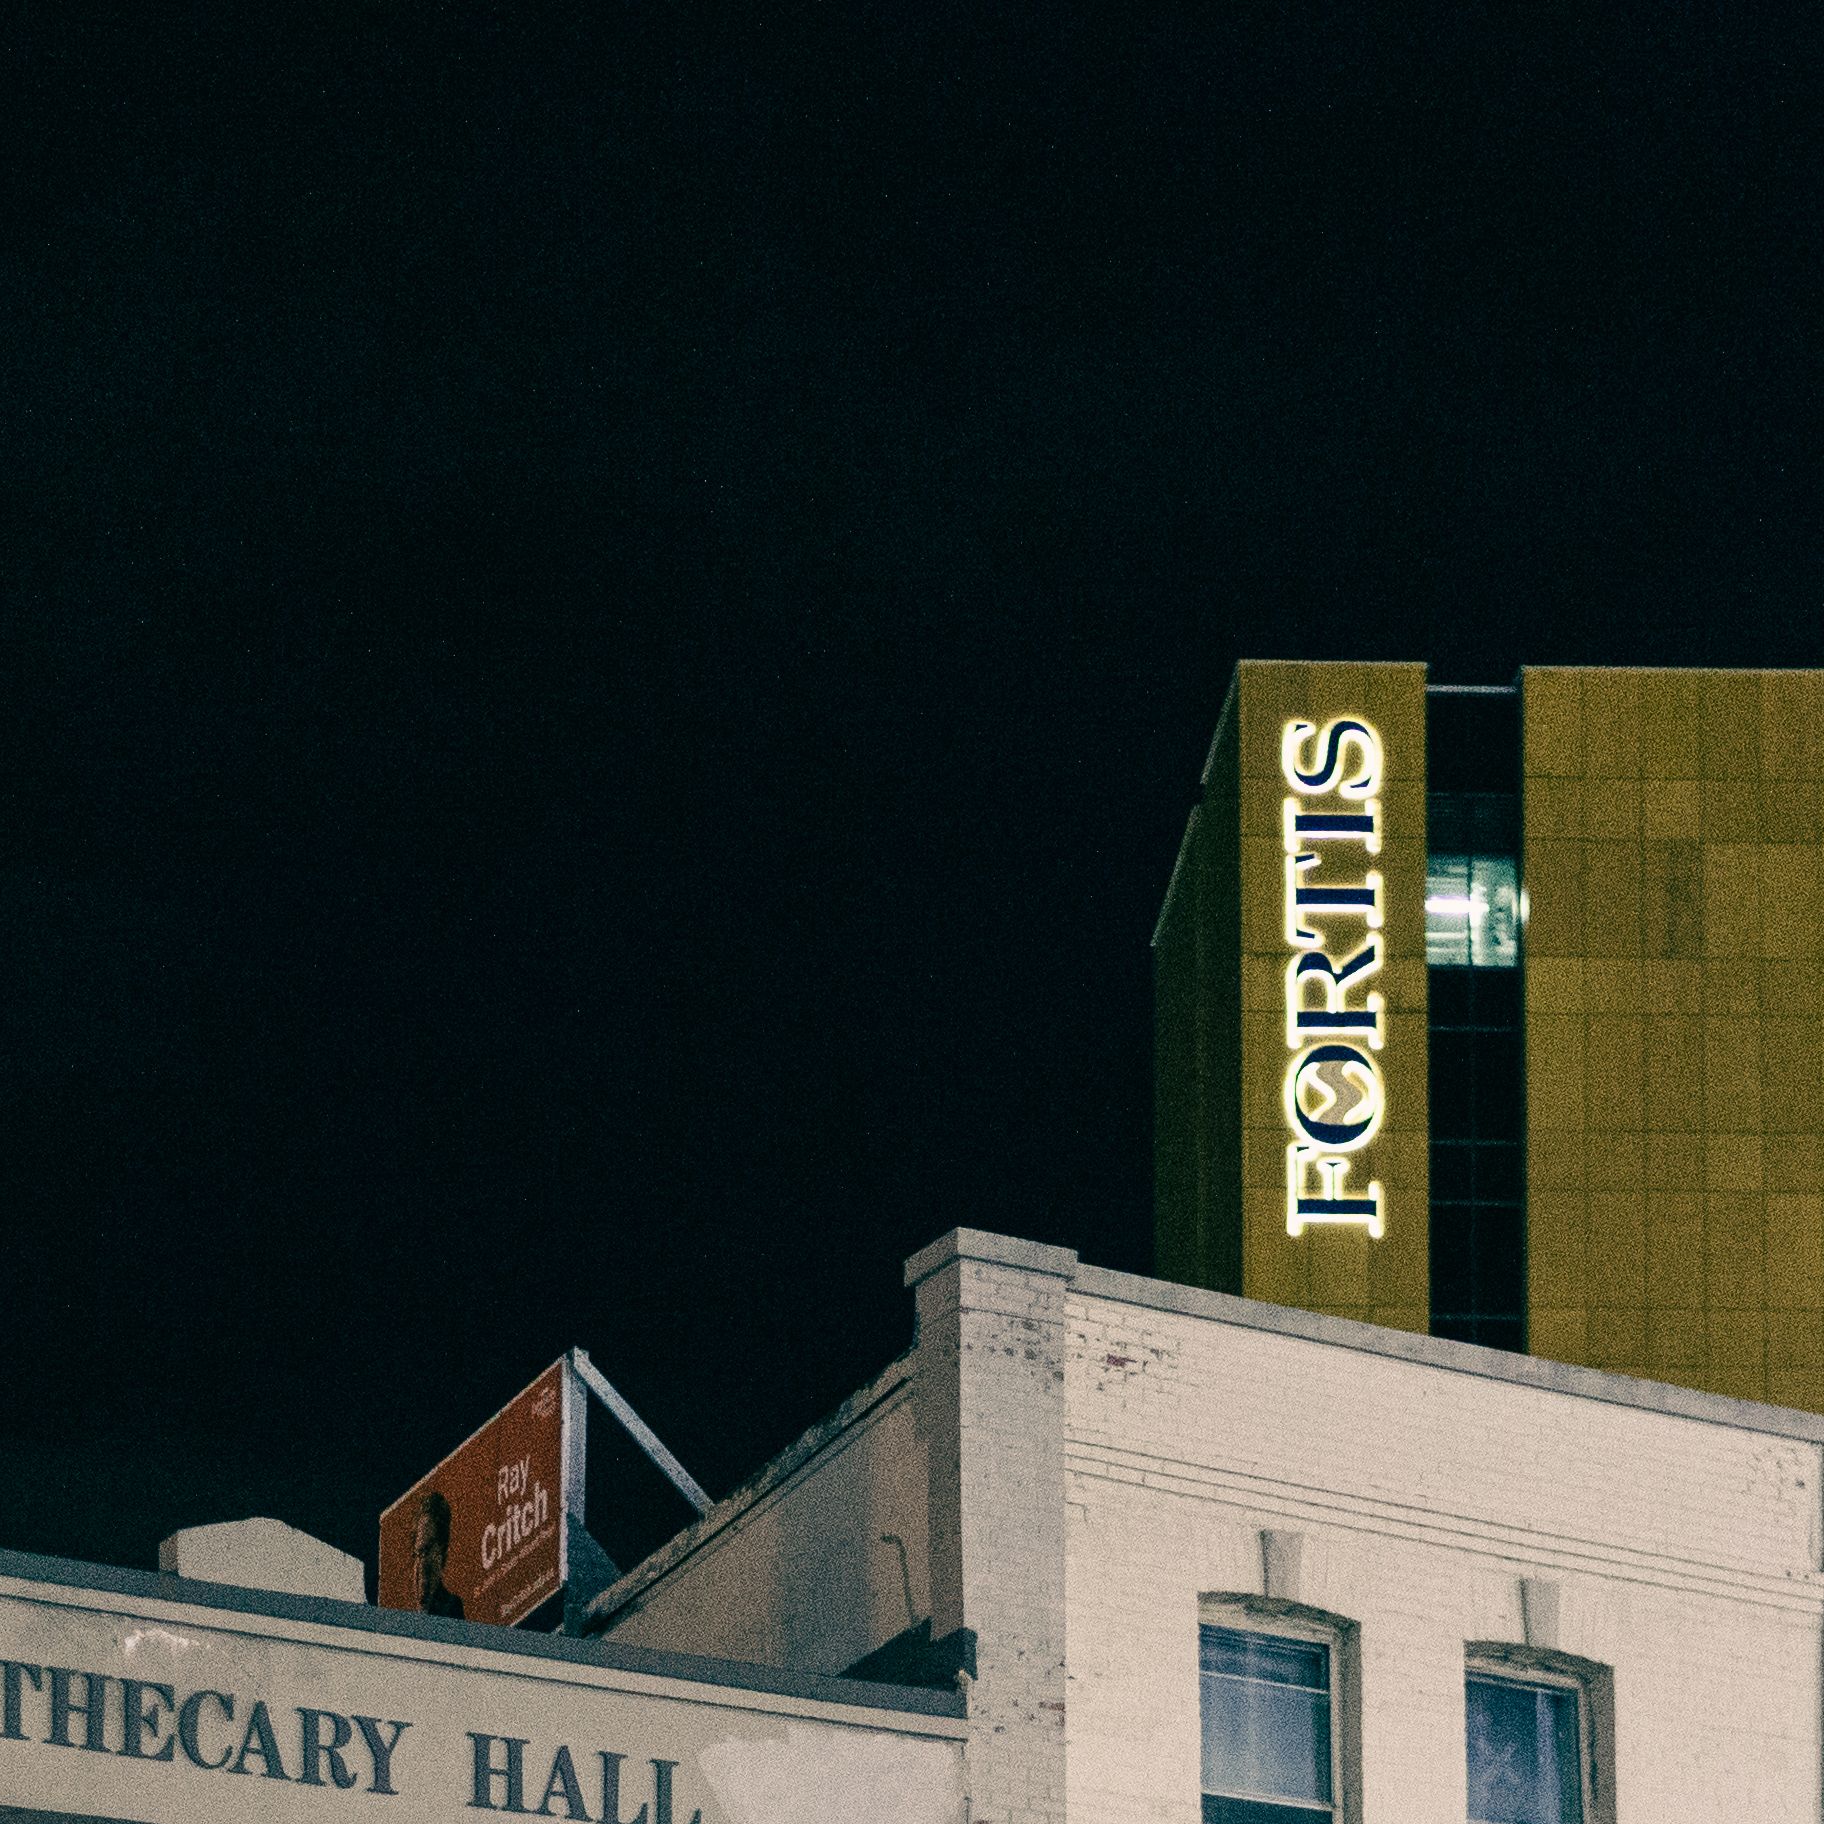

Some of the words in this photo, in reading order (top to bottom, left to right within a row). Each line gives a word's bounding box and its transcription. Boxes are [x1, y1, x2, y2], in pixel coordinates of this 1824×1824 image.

[1282, 718, 1384, 1238] FORTIS
[498, 1455, 530, 1505] Ray
[481, 1481, 548, 1569] Critch
